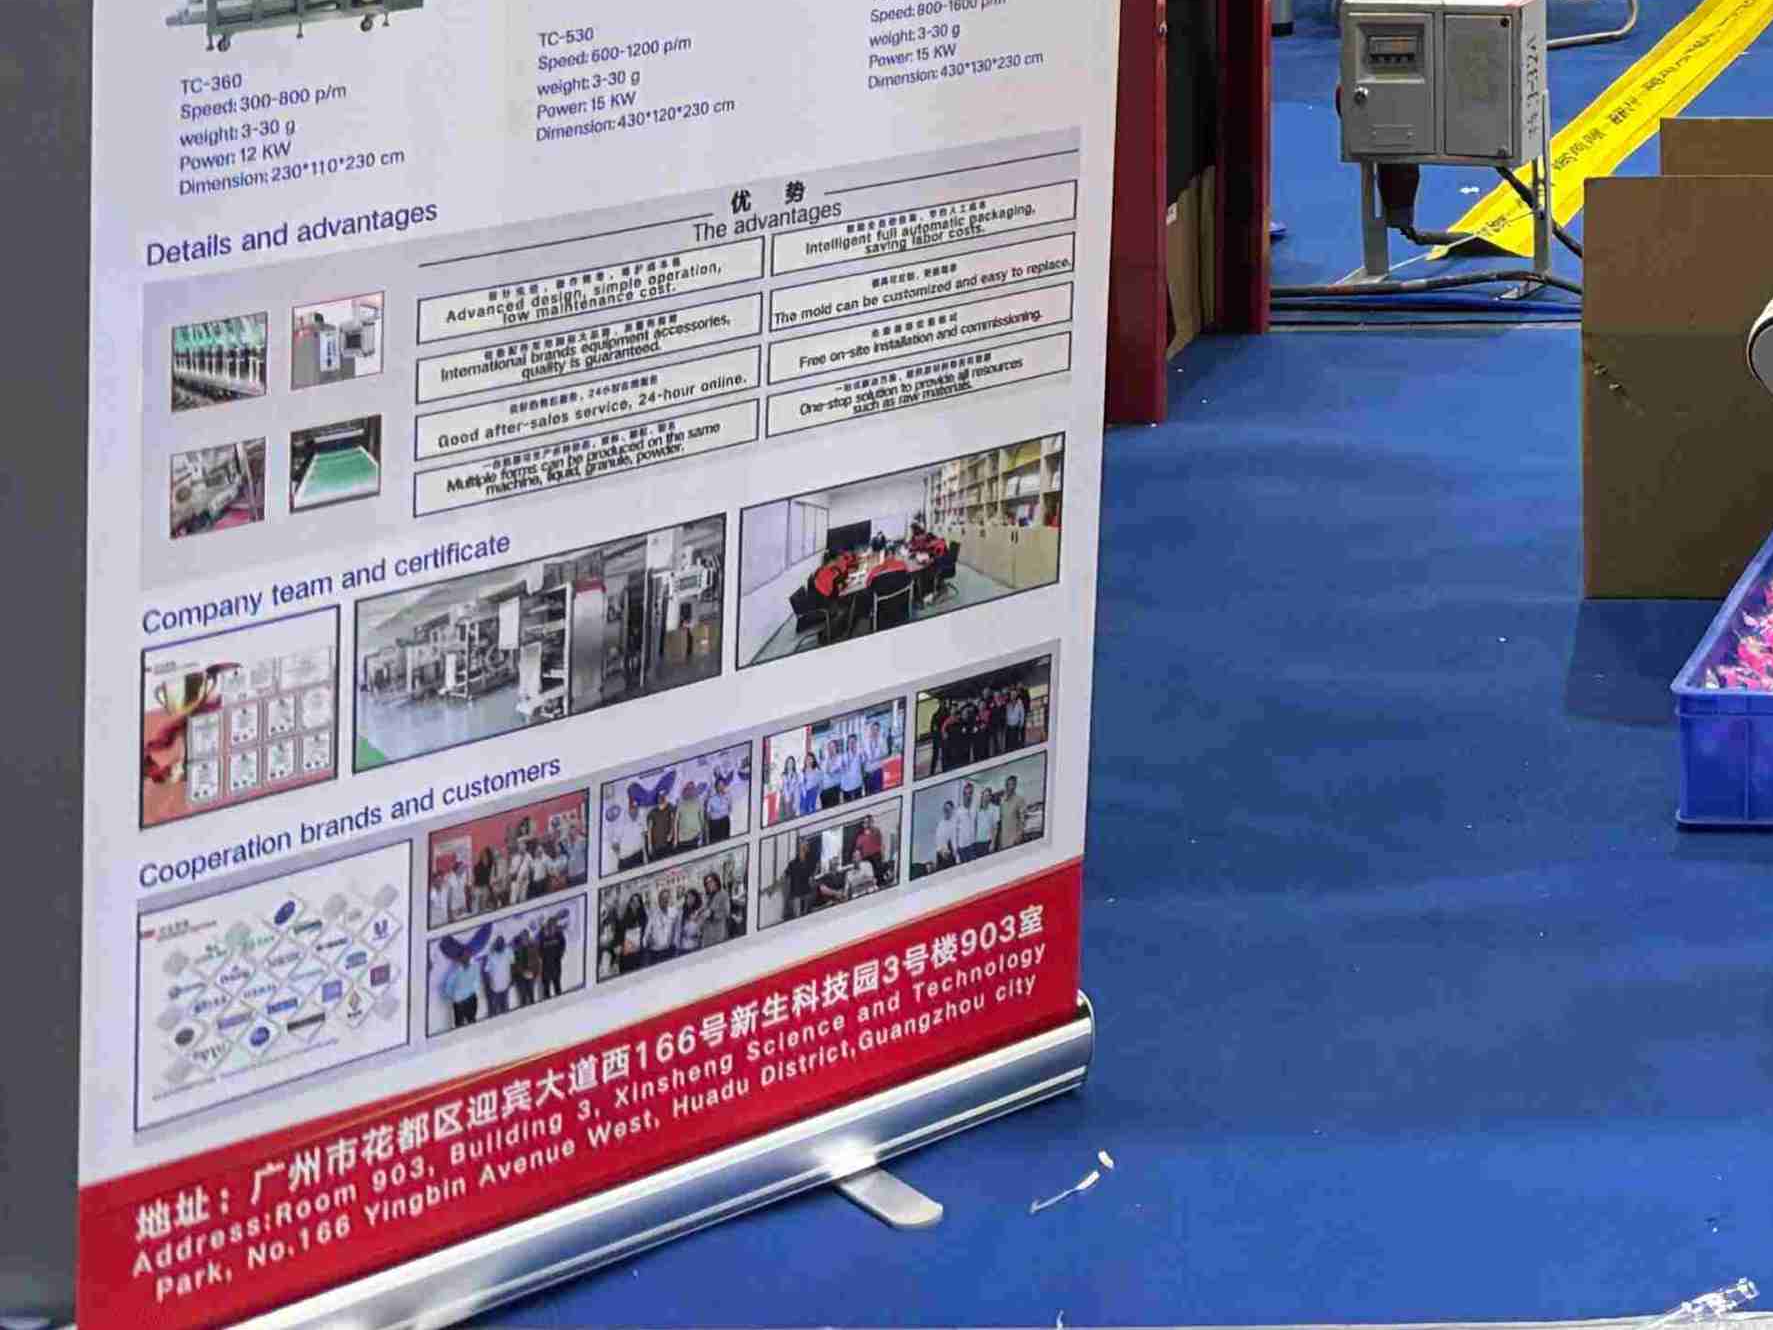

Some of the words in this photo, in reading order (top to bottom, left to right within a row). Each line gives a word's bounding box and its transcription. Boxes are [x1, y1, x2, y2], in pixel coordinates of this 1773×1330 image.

[179, 96, 238, 122] Speed:
[240, 88, 311, 113] 300-800
[314, 83, 348, 105] p/m
[180, 72, 243, 95] TC-360
[241, 120, 281, 140] 3-30
[284, 121, 296, 138] g
[240, 146, 258, 163] 12
[262, 141, 292, 160] KW
[380, 149, 406, 167] cm
[145, 232, 232, 268] Details
[241, 223, 289, 252] and
[296, 202, 439, 244] advantages
[692, 221, 732, 243] The
[733, 200, 843, 236] advantages
[141, 589, 264, 636] Company
[271, 573, 333, 606] team
[341, 557, 387, 590] and
[393, 532, 511, 578] certificate
[138, 829, 293, 889] Cooperation
[300, 804, 383, 846] brands
[390, 787, 435, 821] and
[441, 752, 562, 802] customers
[371, 1157, 436, 1195] 903,
[450, 1111, 565, 1166] Building
[577, 1099, 600, 1122] 3,
[614, 1045, 735, 1110] Xinsheng
[746, 1013, 847, 1064] Science
[857, 993, 901, 1024] and
[912, 942, 1047, 1009] Technology
[155, 1258, 233, 1303] Park,
[246, 1217, 351, 1271] No.166
[363, 1175, 467, 1229] Yingbin
[478, 1138, 577, 1188] Avenue
[587, 1112, 660, 1150] West,
[672, 1076, 751, 1121] Huadu
[994, 971, 1037, 1006] city
